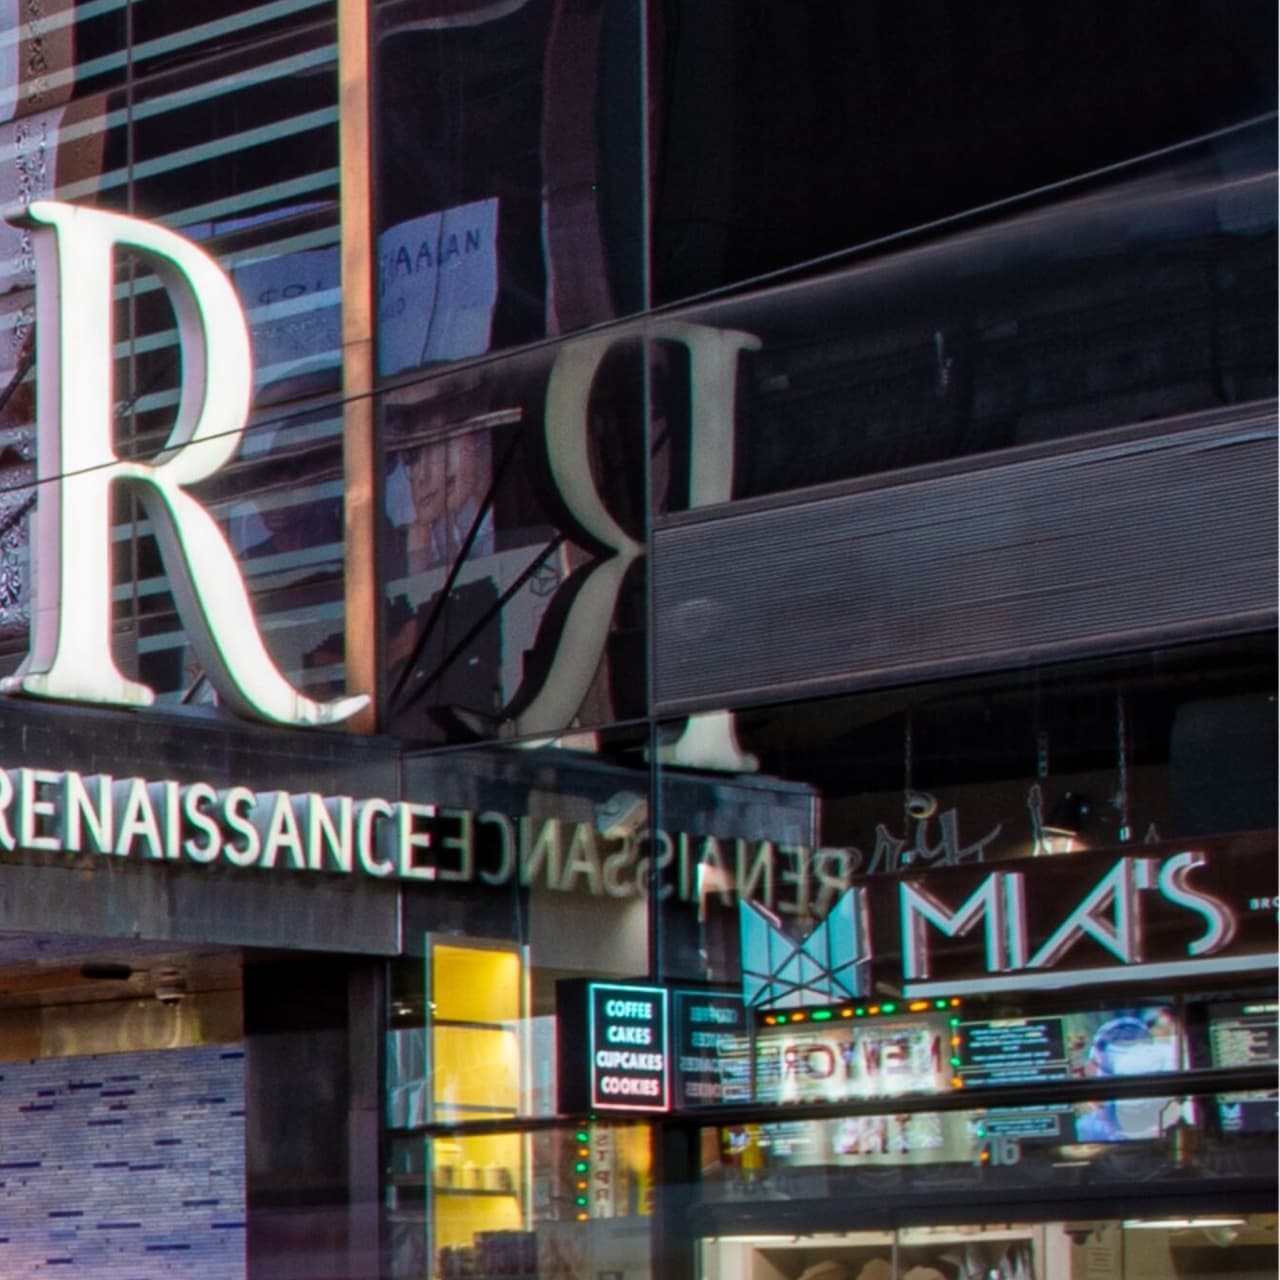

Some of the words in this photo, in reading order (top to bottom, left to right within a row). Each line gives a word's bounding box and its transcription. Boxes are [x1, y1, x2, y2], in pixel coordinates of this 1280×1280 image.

[605, 999, 653, 1020] COFFEE
[606, 1025, 652, 1045] CAKES
[596, 1050, 663, 1071] CUPCAKES
[600, 1076, 660, 1096] COOKIES
